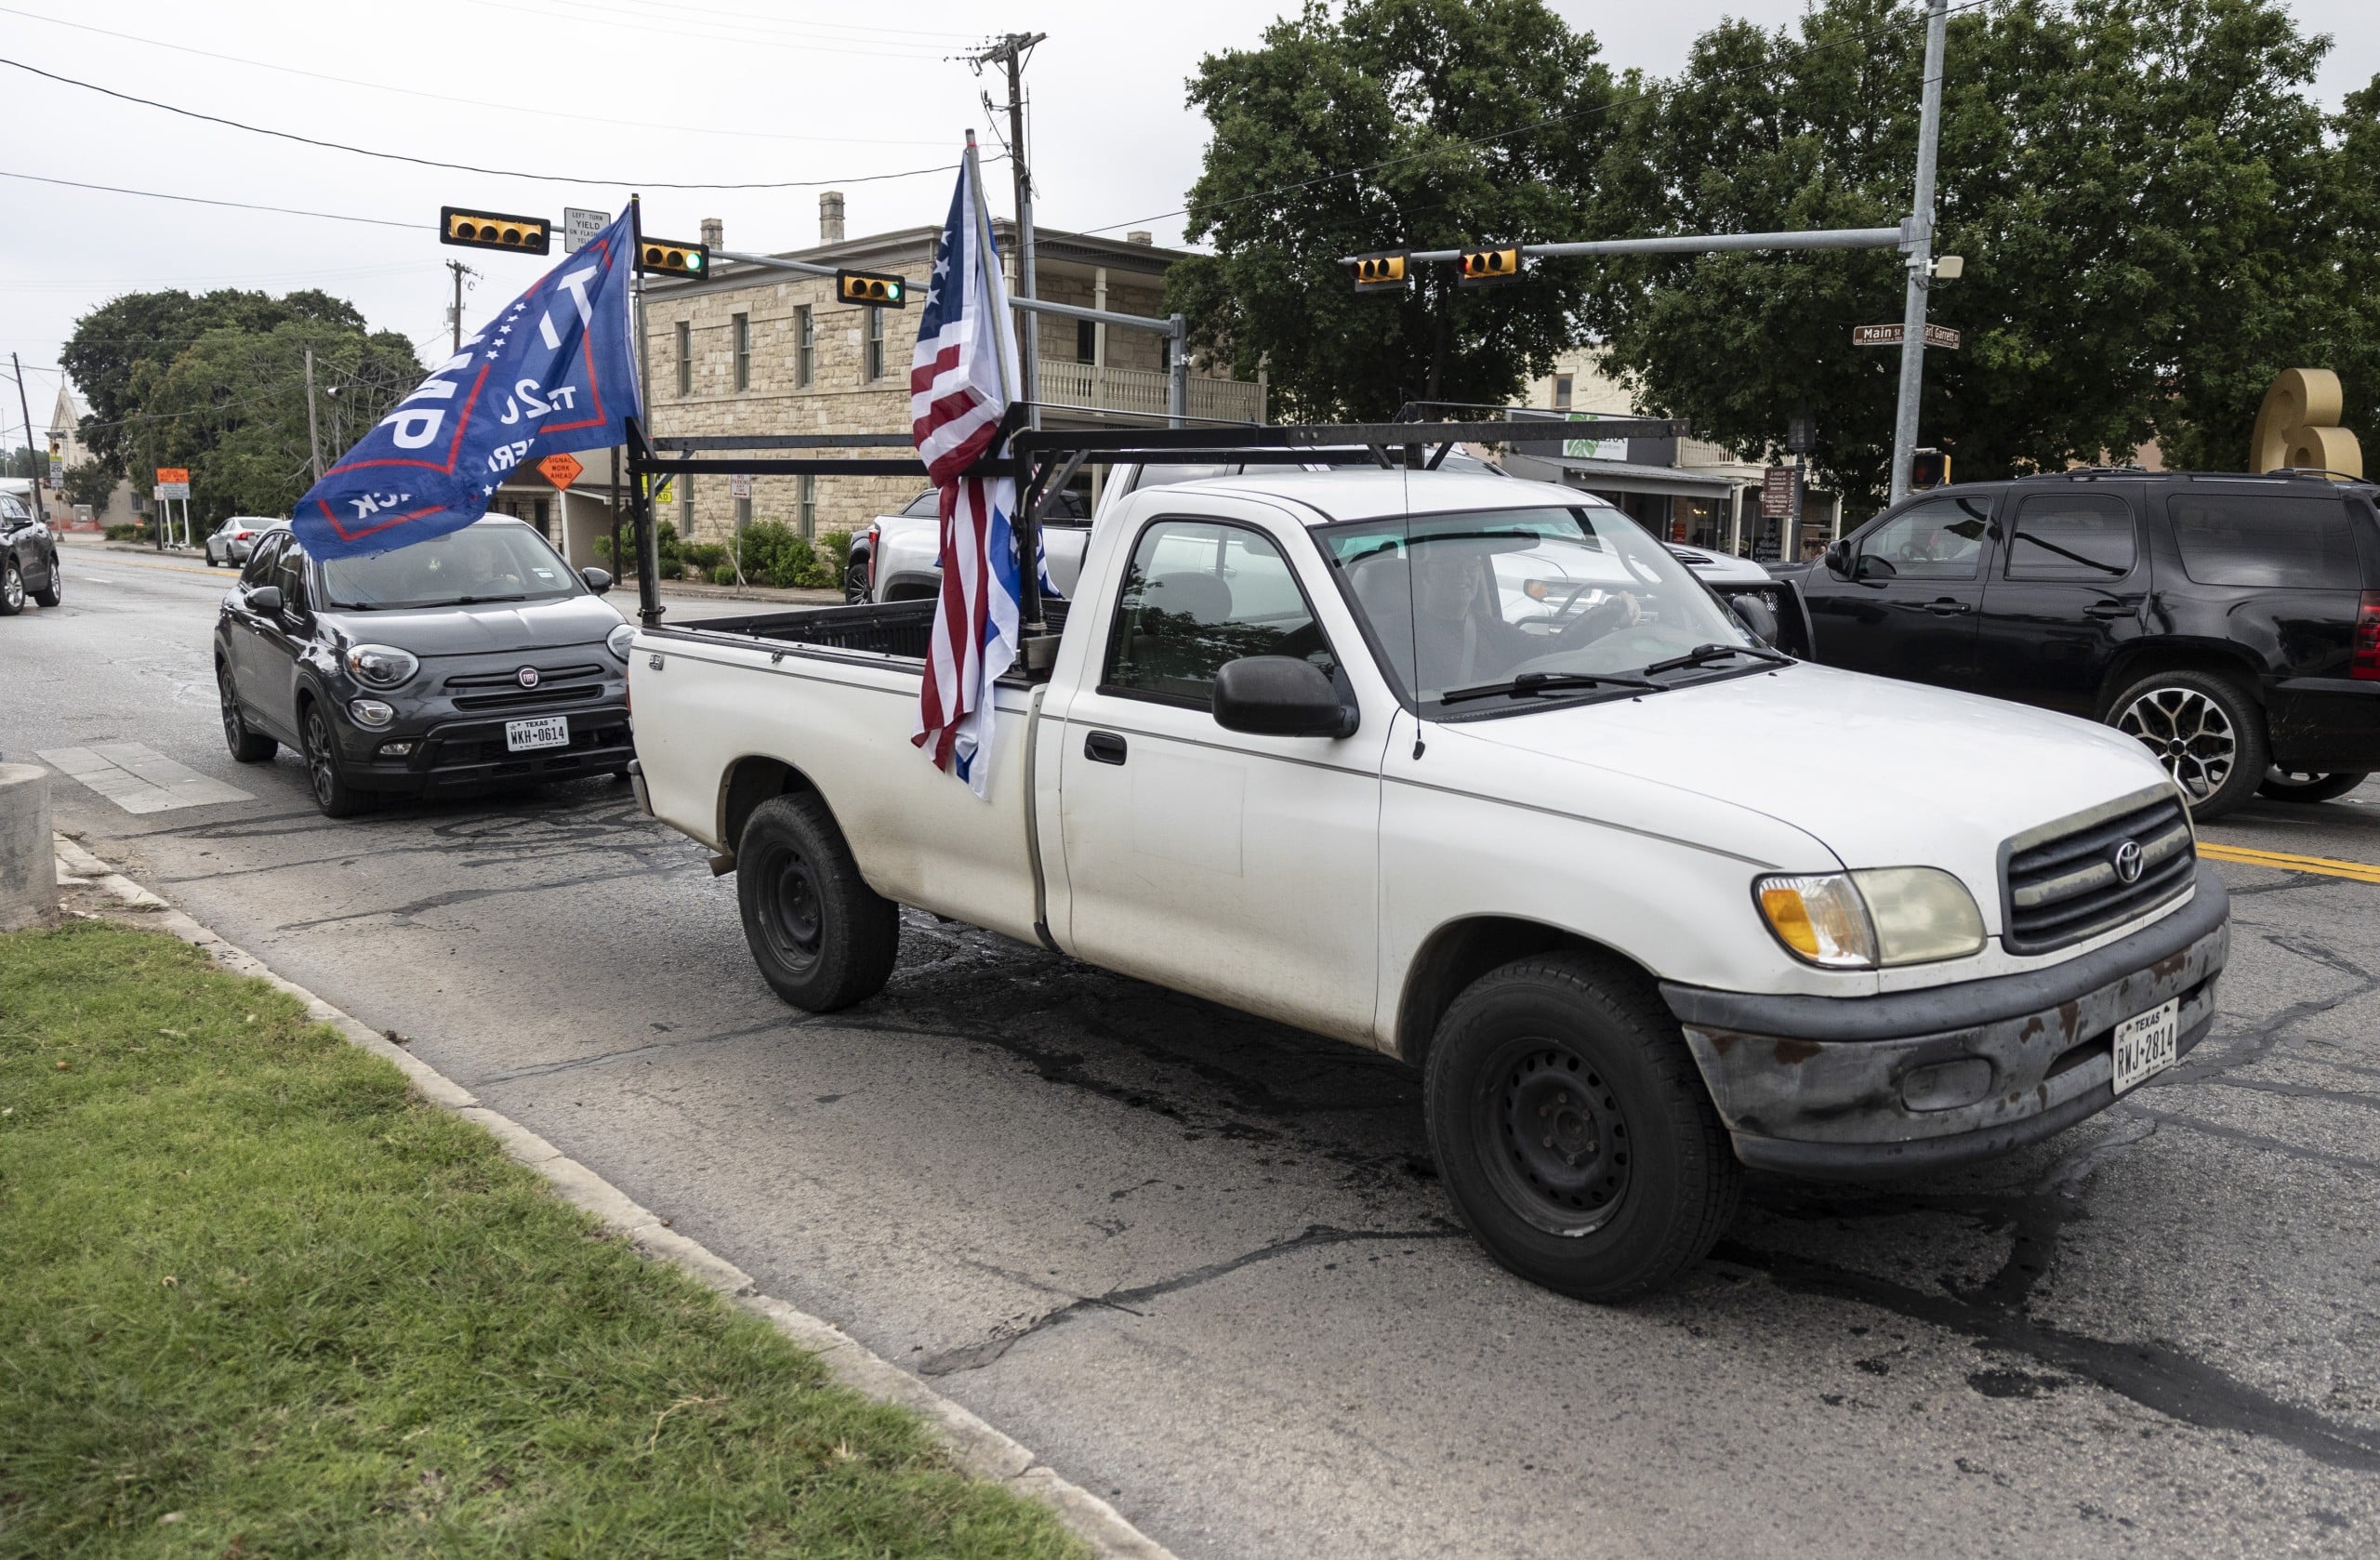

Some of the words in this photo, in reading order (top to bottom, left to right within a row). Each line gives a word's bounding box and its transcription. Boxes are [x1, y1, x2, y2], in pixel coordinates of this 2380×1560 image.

[576, 220, 601, 230] YIELD
[1863, 327, 1892, 338] Main
[1924, 326, 1934, 337] arl
[1935, 327, 1954, 342] Garrett
[522, 673, 535, 682] FIAT
[525, 720, 549, 728] TEXAS
[2135, 1011, 2161, 1033] TEXAS
